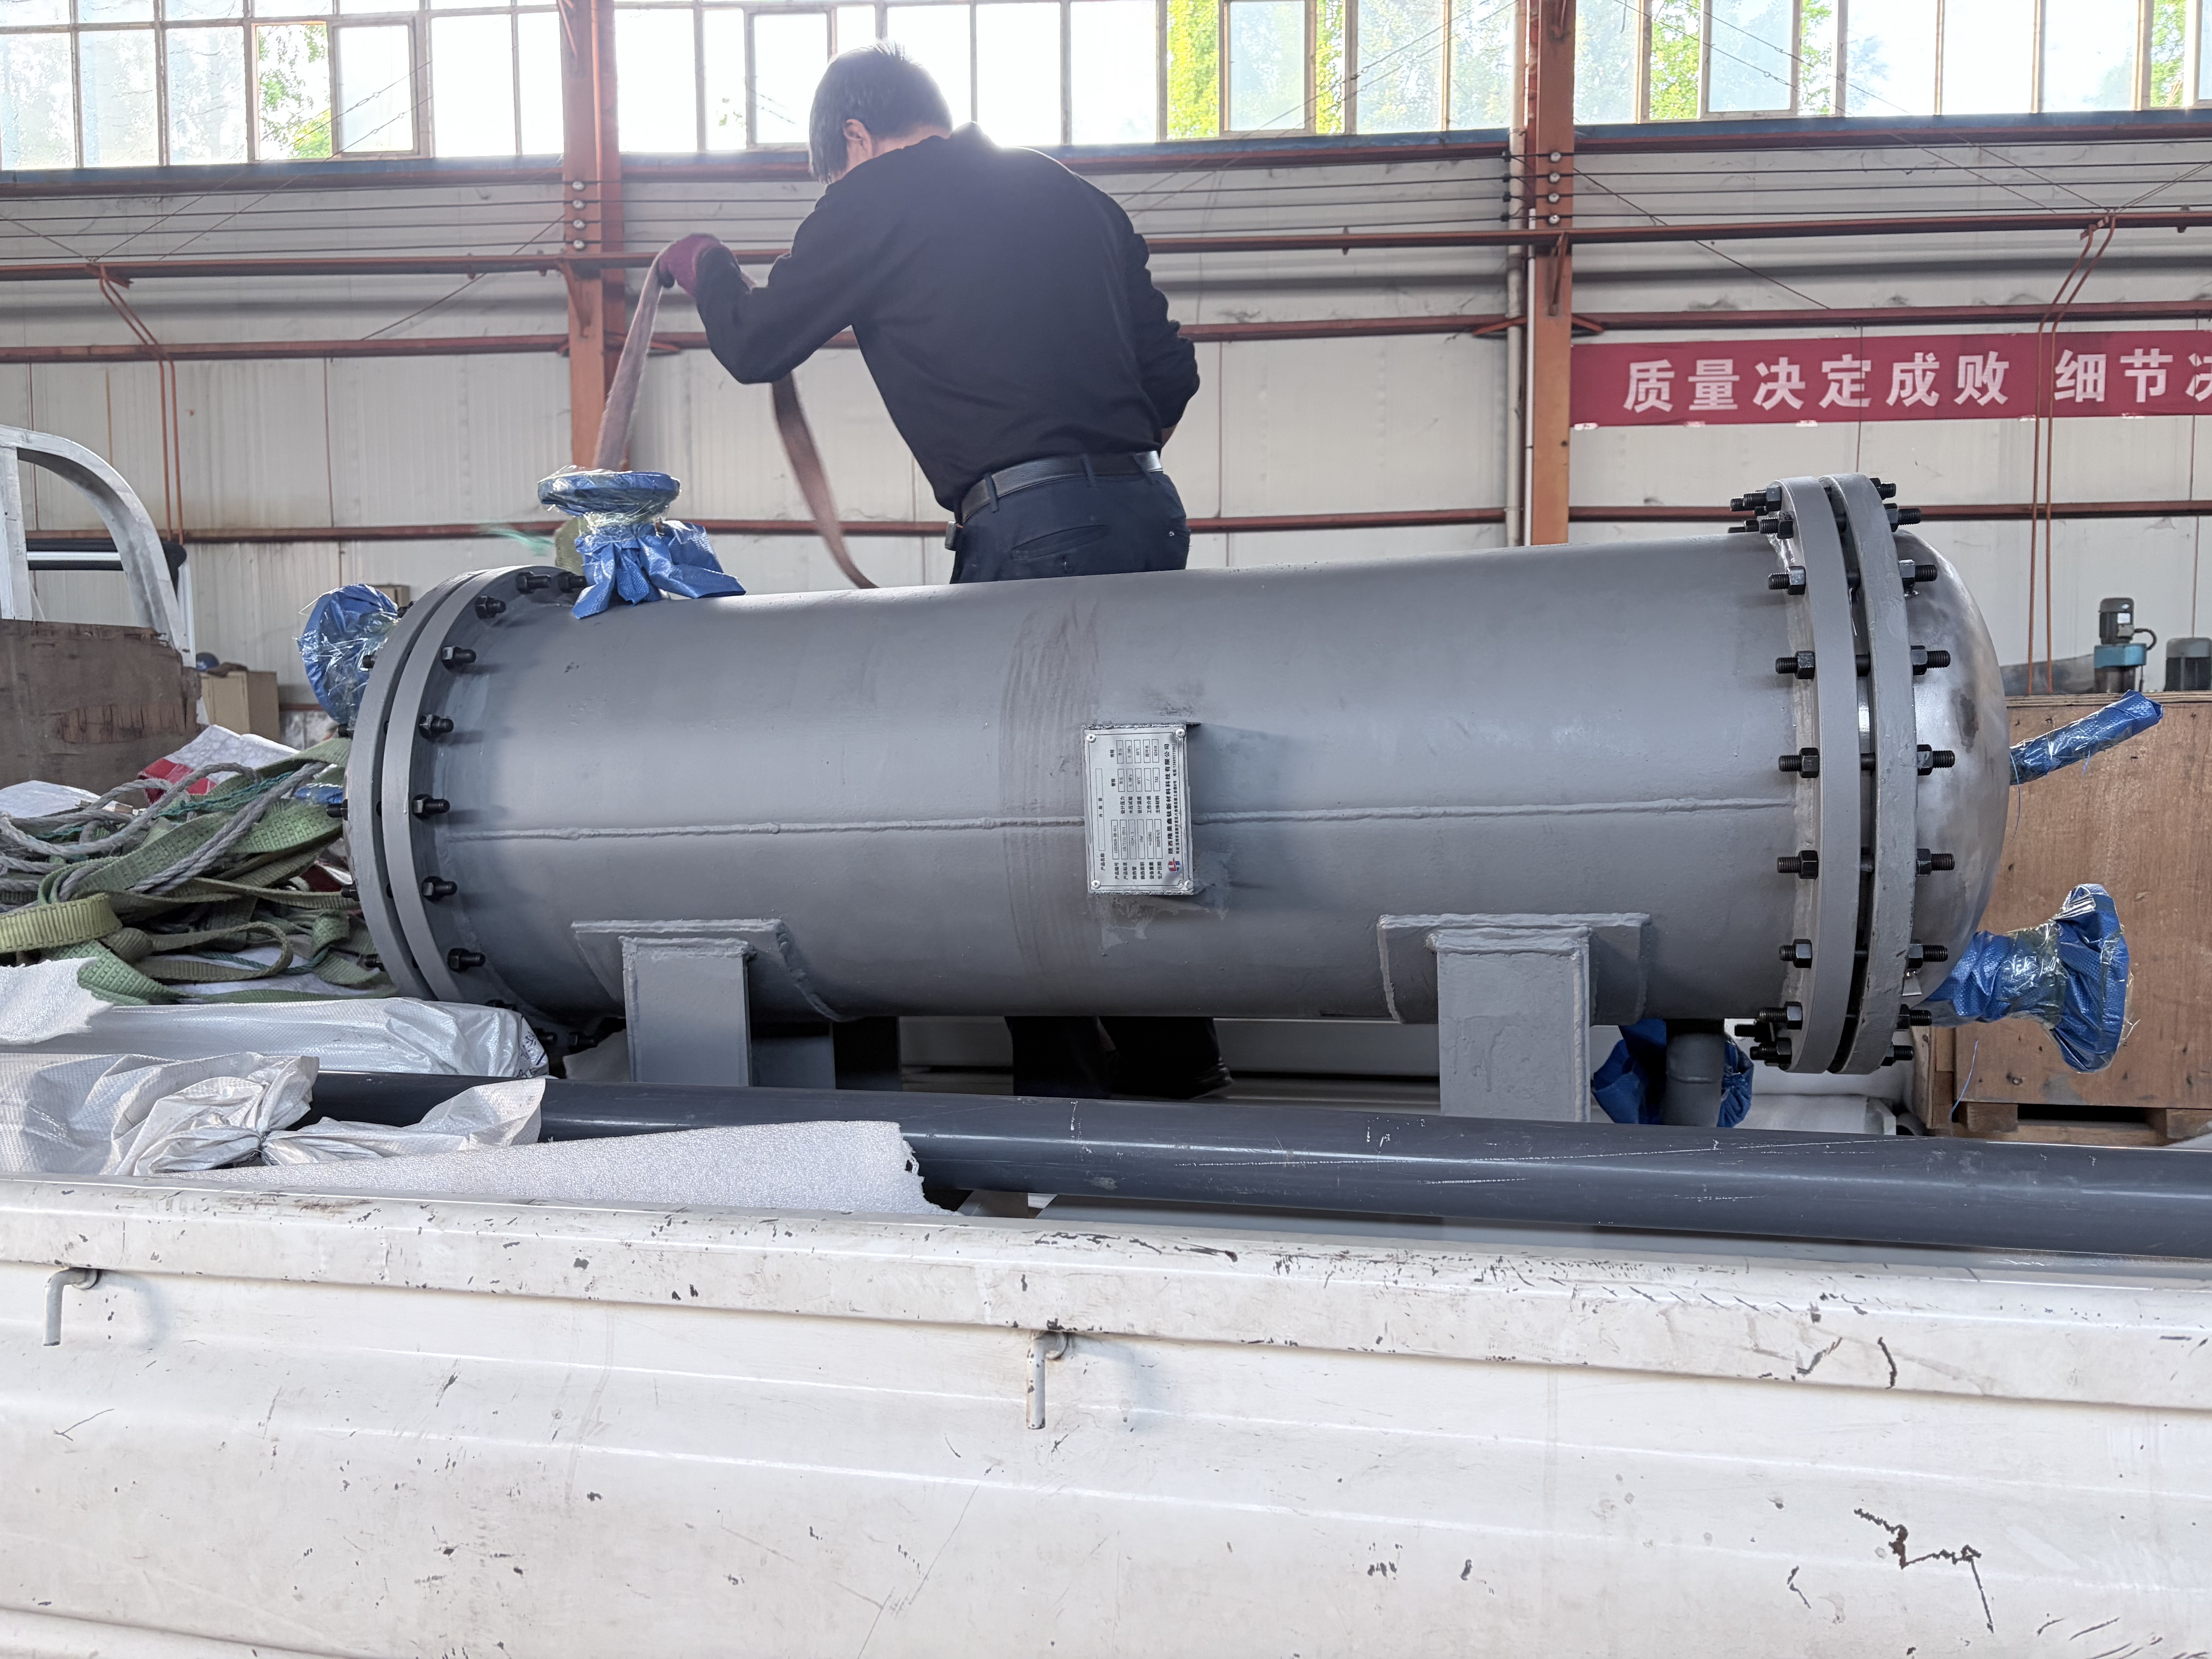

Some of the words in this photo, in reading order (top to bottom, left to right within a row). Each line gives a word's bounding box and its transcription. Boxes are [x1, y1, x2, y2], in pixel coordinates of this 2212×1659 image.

[1623, 351, 2009, 413] 质量决定成败
[1111, 778, 1115, 787] 管程
